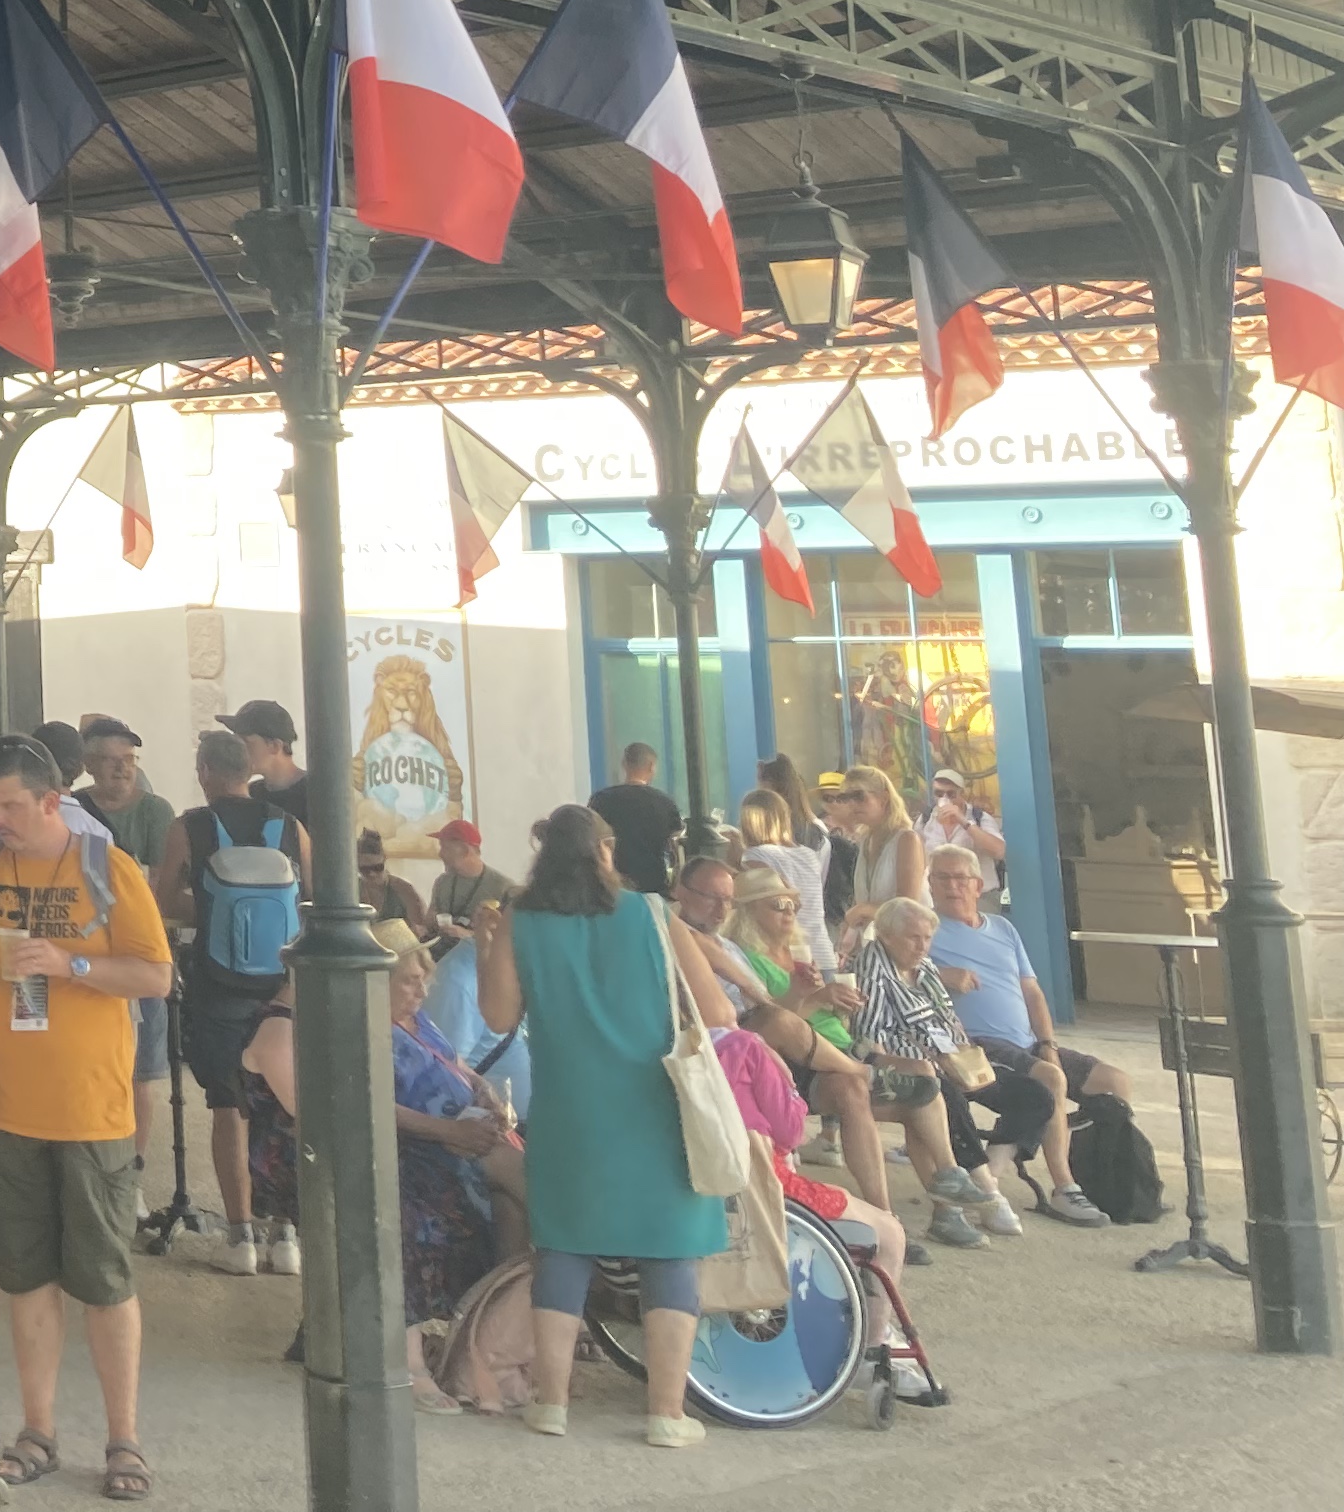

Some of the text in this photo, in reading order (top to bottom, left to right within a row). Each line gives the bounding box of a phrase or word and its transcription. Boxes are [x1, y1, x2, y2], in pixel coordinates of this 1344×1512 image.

[368, 755, 447, 793] ROCHET
[33, 887, 80, 903] NATURE
[32, 904, 70, 920] NEEDS
[30, 922, 79, 939] HEROES
